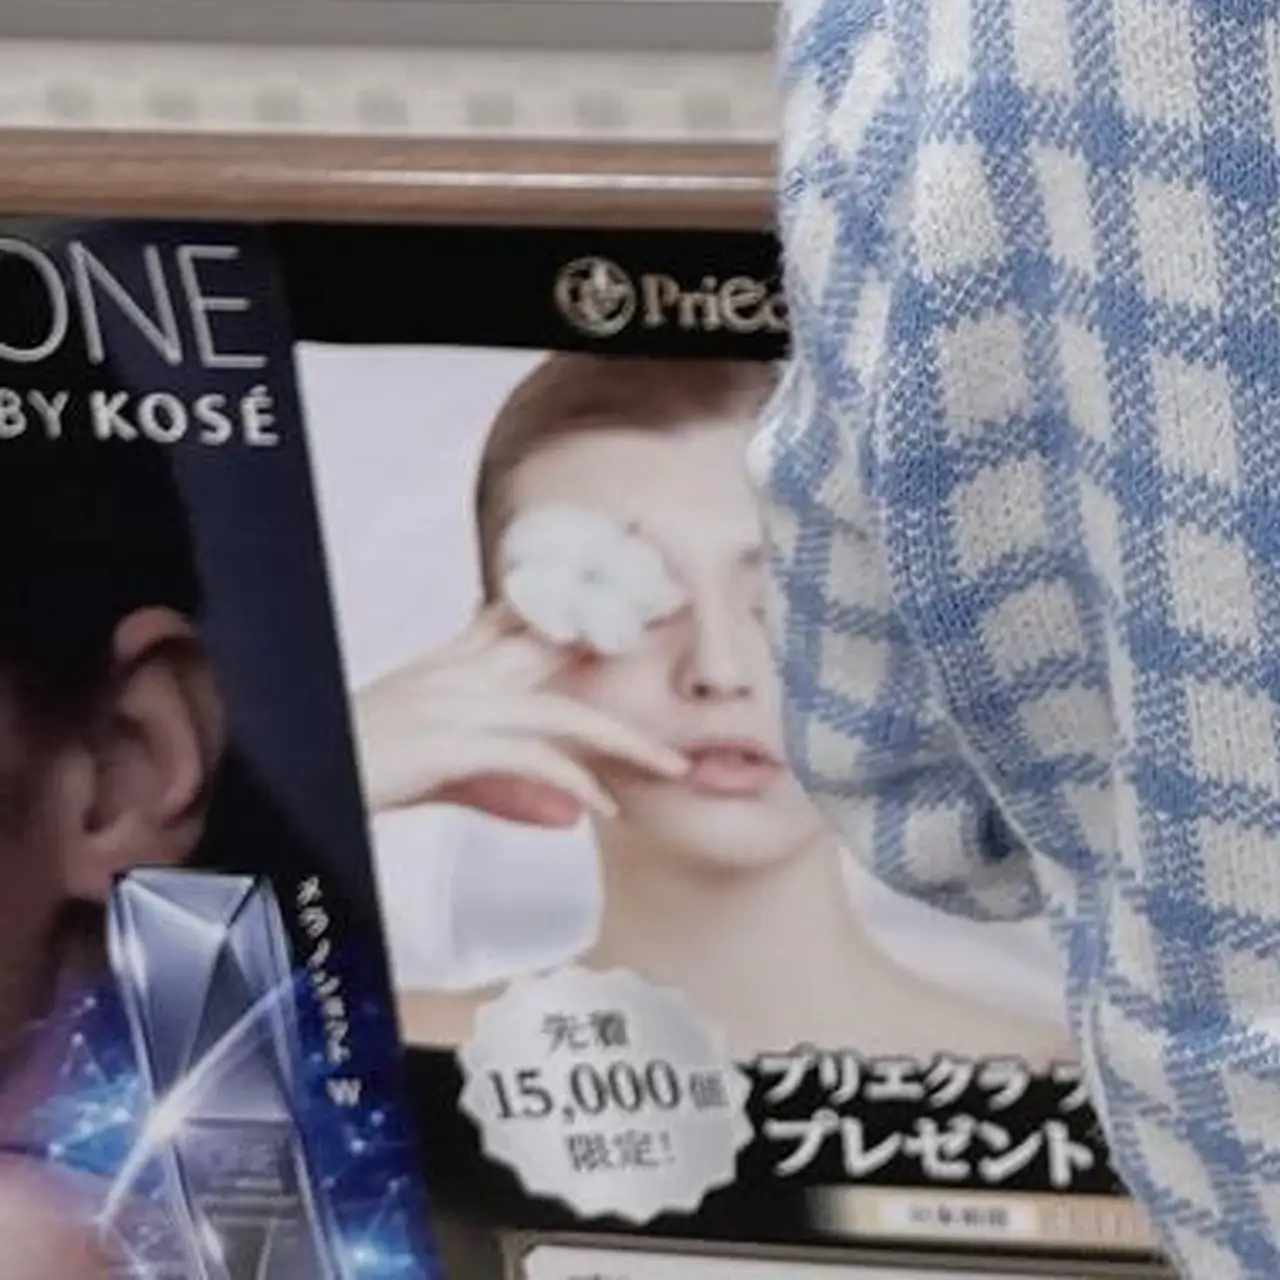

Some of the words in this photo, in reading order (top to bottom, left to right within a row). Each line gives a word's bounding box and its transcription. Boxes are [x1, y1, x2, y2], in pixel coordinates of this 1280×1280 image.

[0, 238, 268, 368] ONE
[0, 387, 69, 439] BY
[90, 385, 279, 446] KOSÉ
[762, 1108, 1095, 1187] プレゼント
